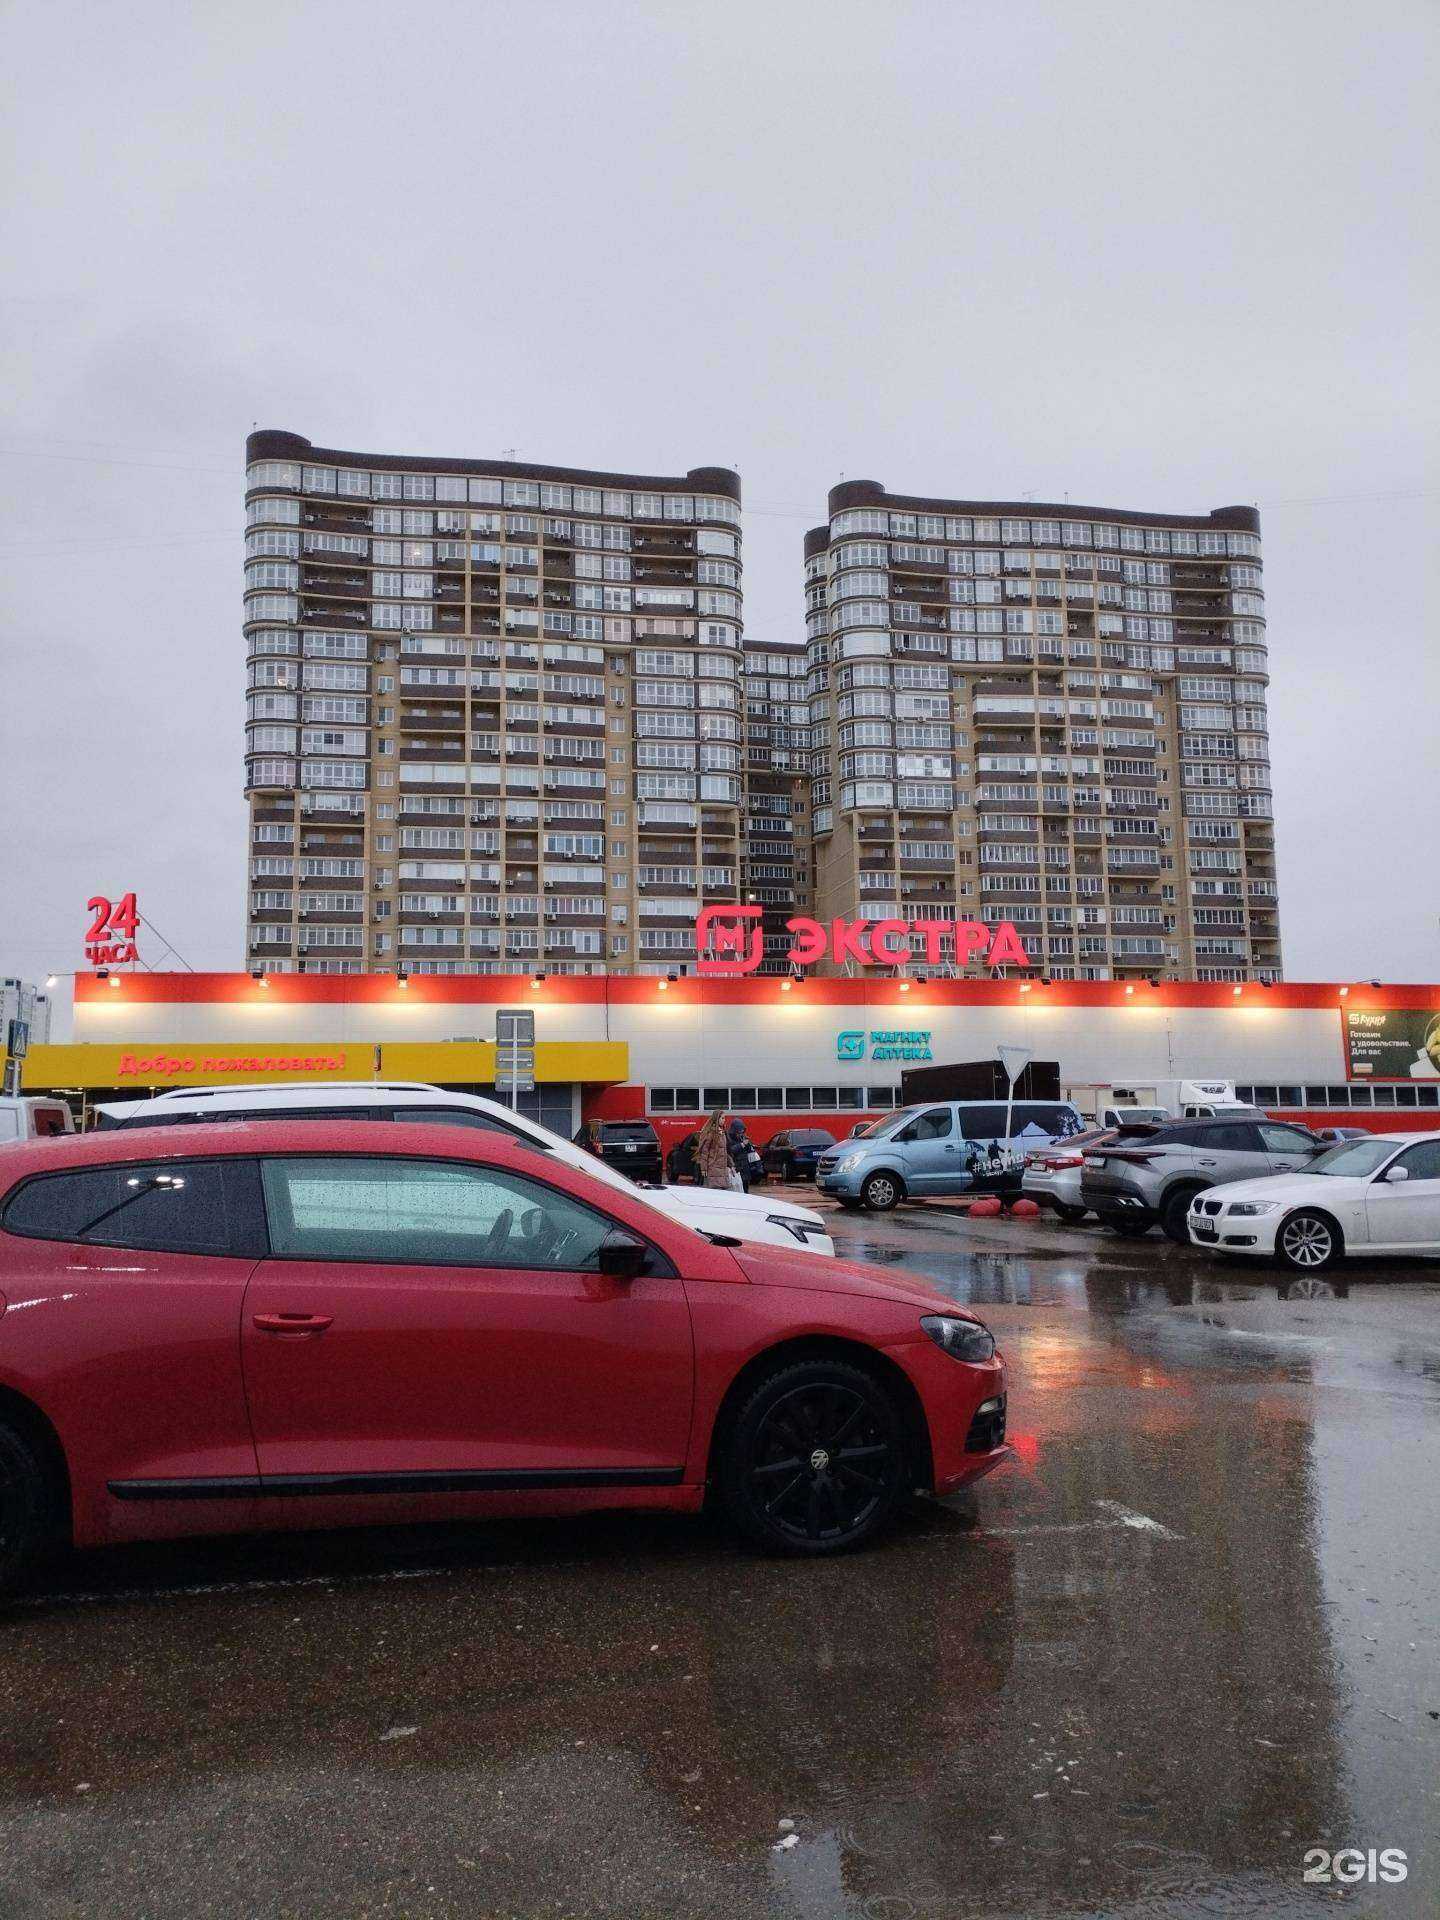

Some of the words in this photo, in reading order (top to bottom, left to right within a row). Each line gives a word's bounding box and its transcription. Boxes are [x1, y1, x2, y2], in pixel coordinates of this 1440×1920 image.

[86, 893, 140, 942] 24
[85, 943, 140, 965] ЧАСА
[786, 917, 1031, 968] ЭКСТРА
[118, 1054, 197, 1076] Добро
[201, 1052, 346, 1072] пожаловать!
[872, 1047, 934, 1060] АПТЕКА
